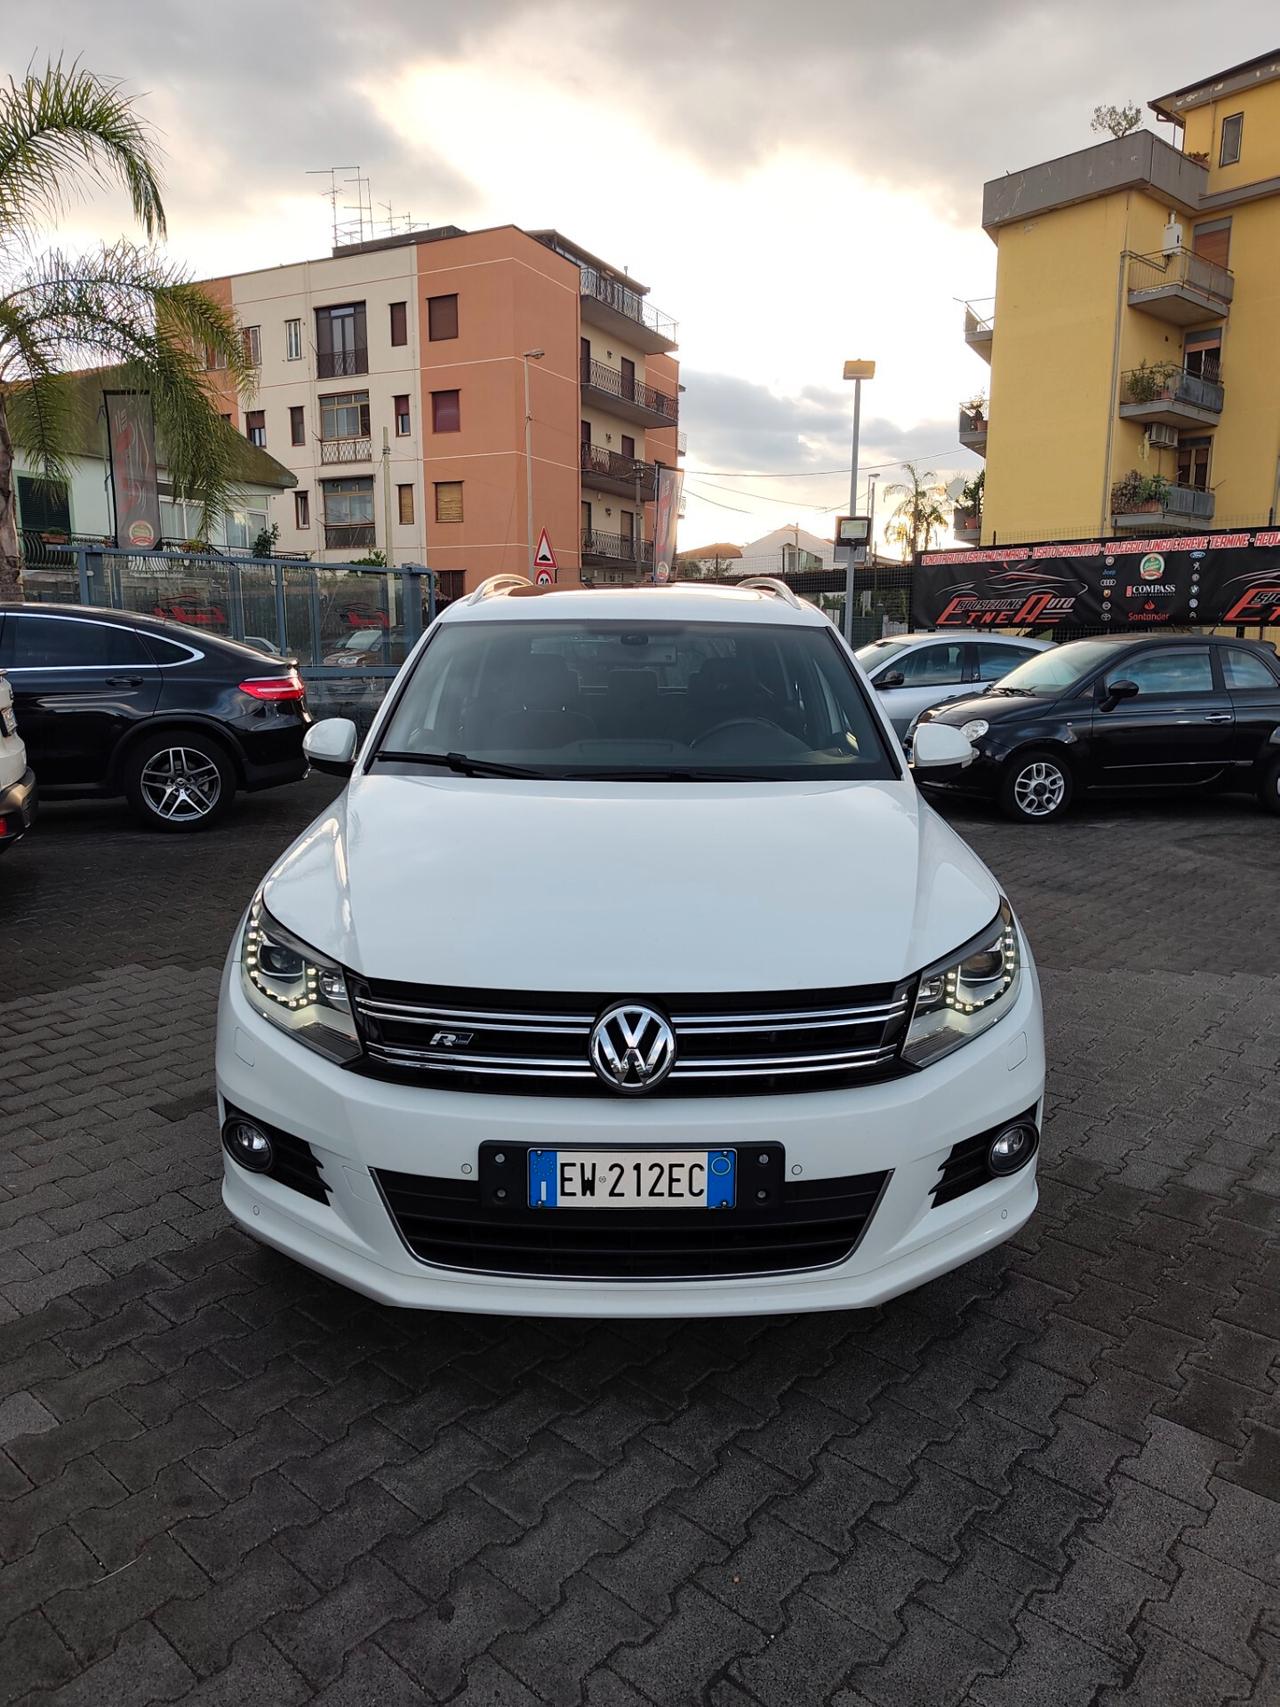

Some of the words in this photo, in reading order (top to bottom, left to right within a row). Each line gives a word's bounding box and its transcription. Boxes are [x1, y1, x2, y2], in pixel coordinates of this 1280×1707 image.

[1032, 546, 1057, 559] USATO
[1056, 543, 1101, 558] GARANTITO
[1104, 541, 1143, 555] NOLEGGIO
[1142, 538, 1172, 552] LUNGO
[1179, 536, 1209, 550] BREVE
[1209, 533, 1250, 549] TERMINE
[1132, 584, 1176, 593] COMPASS
[1128, 612, 1169, 621] Santander
